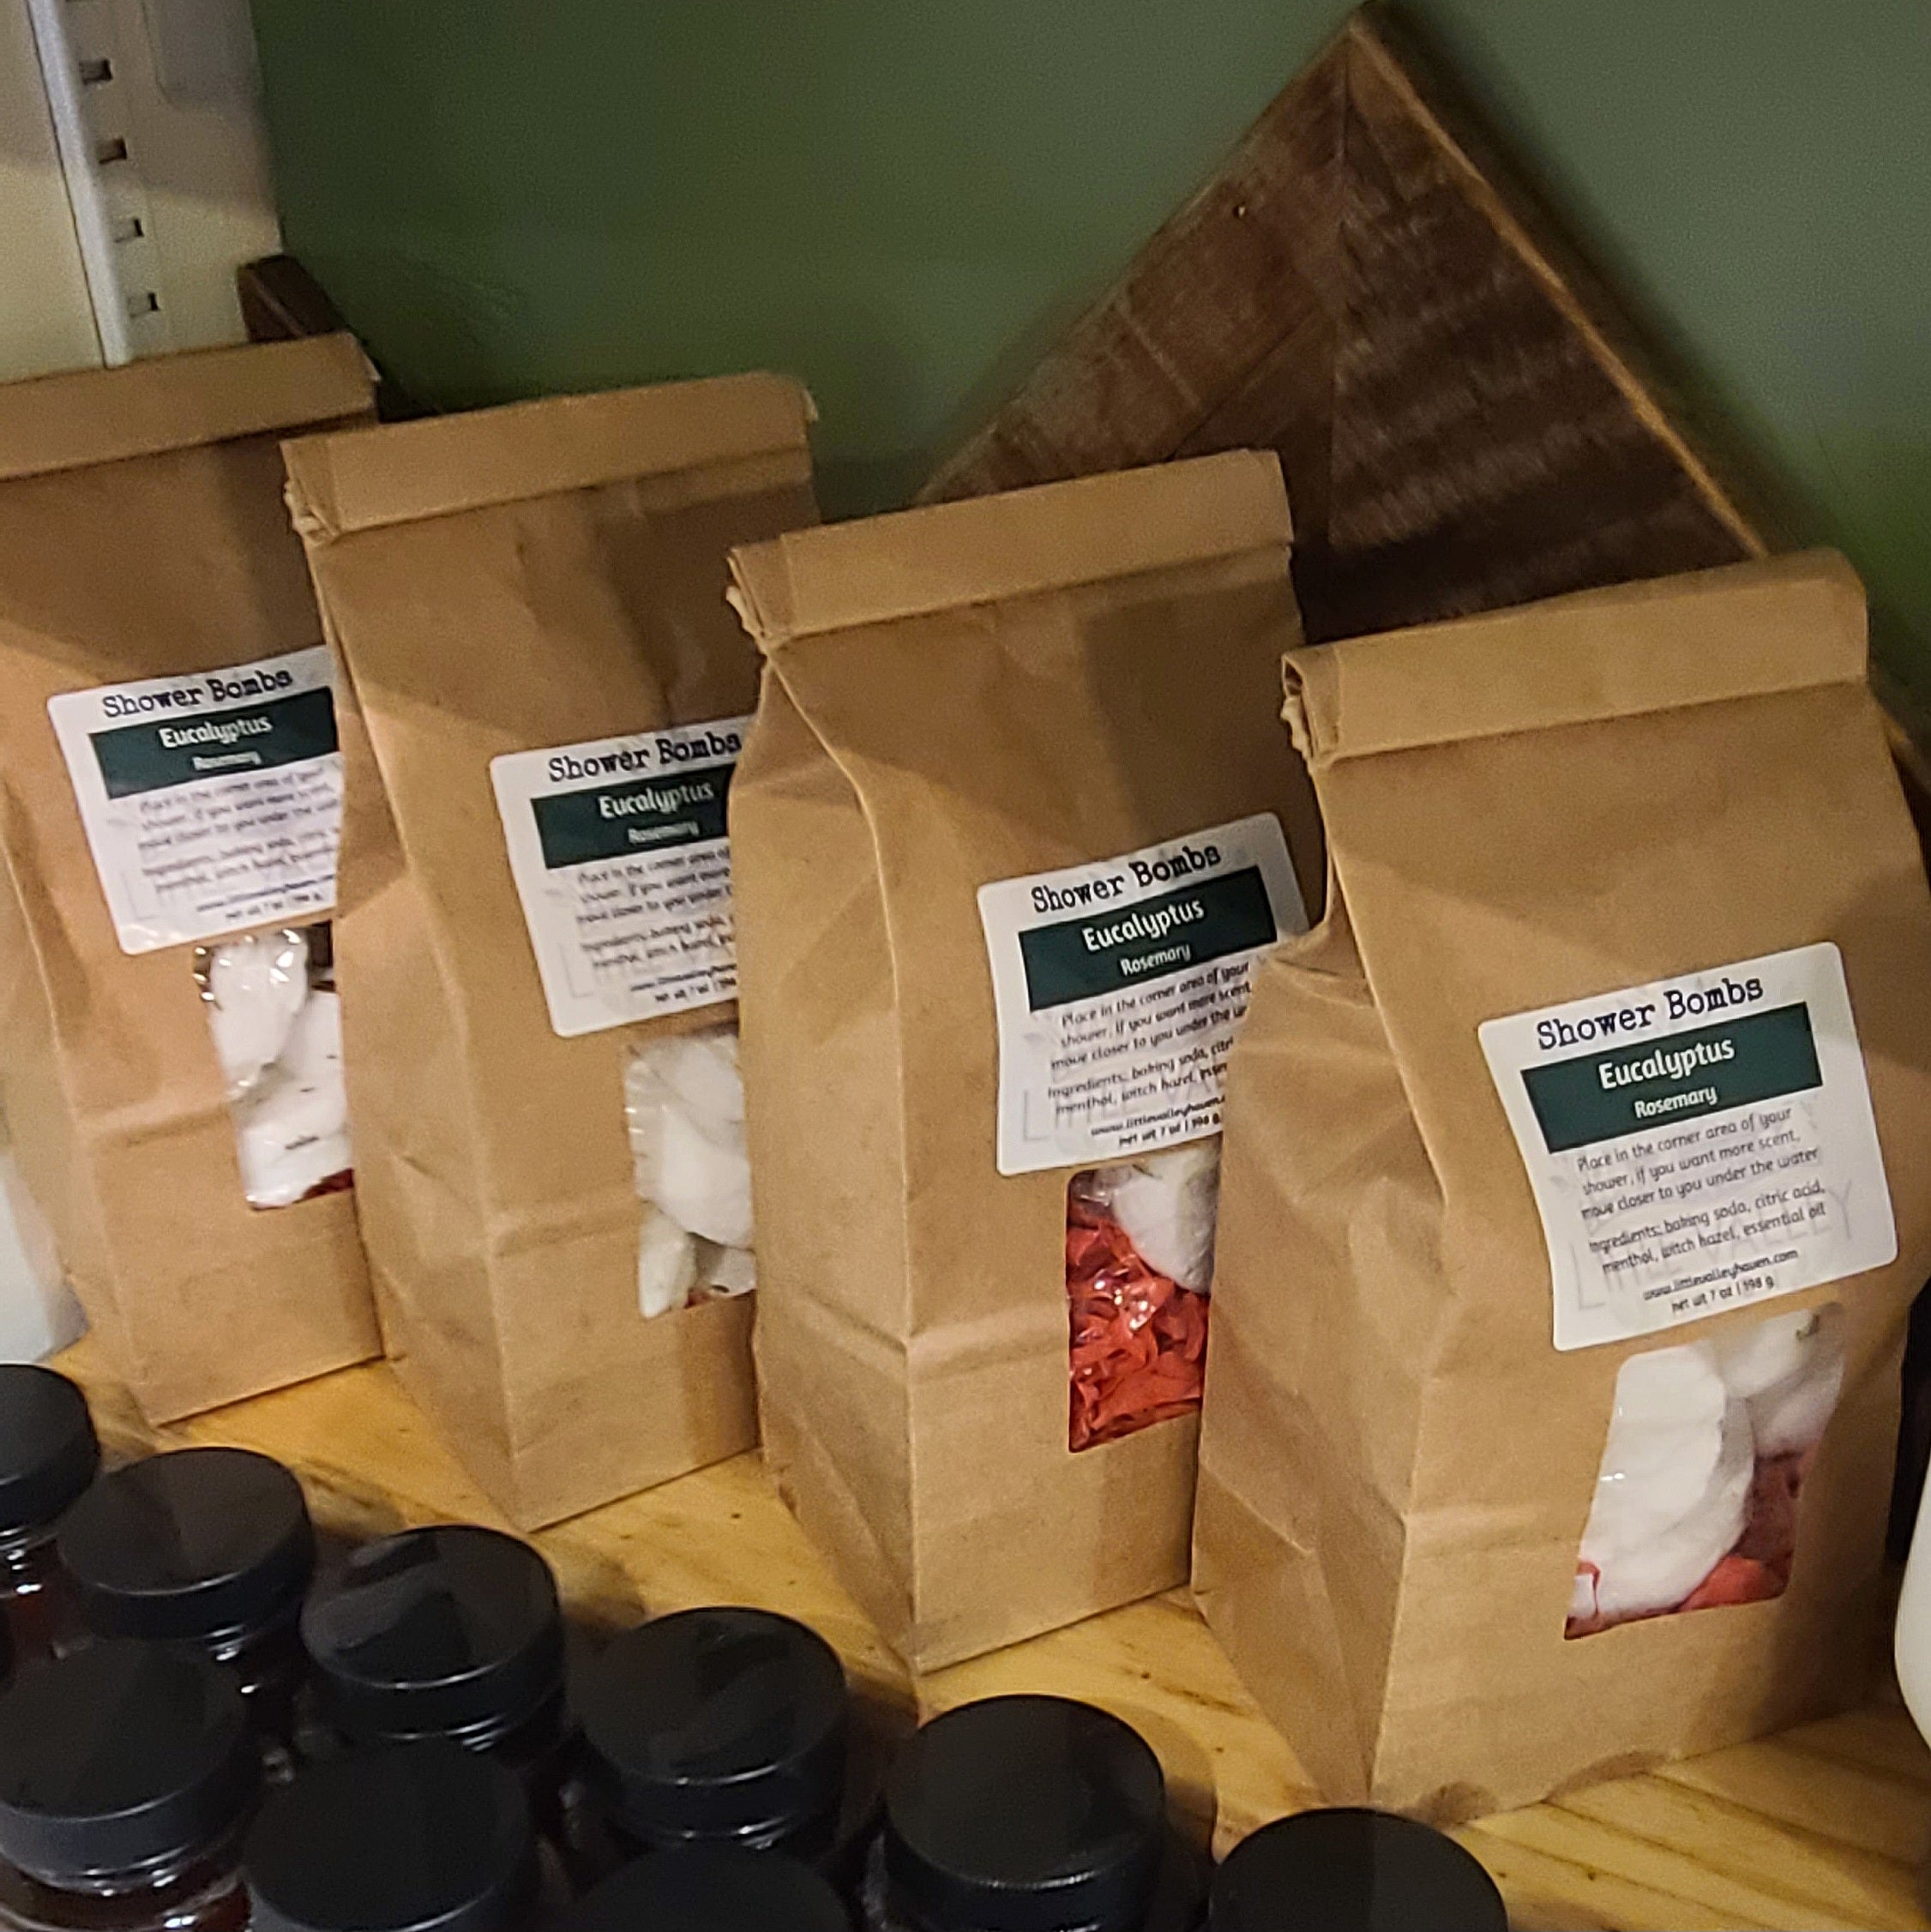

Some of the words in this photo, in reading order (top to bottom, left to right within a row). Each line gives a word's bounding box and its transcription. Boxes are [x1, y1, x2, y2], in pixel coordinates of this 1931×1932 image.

[104, 689, 202, 718] Shower
[208, 671, 292, 700] Bombs
[159, 717, 272, 749] Eucalyptus
[550, 750, 648, 782] Shower
[657, 731, 741, 763] Bombs
[599, 784, 714, 819] Eucalyptus
[1032, 876, 1123, 912] Shower
[1130, 846, 1220, 887] Bombs
[1083, 900, 1203, 951] Eucalyptus
[1121, 945, 1191, 976] Rosemary
[1062, 1008, 1098, 1029] Place
[1116, 996, 1137, 1013] the
[1140, 986, 1176, 1004] corner
[1221, 960, 1249, 984] your
[1537, 1004, 1654, 1050] Shower
[1664, 978, 1763, 1019] Bombs
[1128, 1014, 1152, 1032] you
[1133, 1036, 1147, 1051] to
[1150, 1028, 1174, 1048] you
[1598, 1039, 1735, 1089] Eucalyptus
[1635, 1087, 1717, 1118] Rosemary
[1576, 1153, 1612, 1173] Place
[1614, 1147, 1629, 1164] in
[1631, 1142, 1654, 1159] the
[1657, 1131, 1701, 1153] corner
[1705, 1122, 1738, 1140] area
[1740, 1112, 1755, 1133] of
[1759, 1107, 1792, 1130] your
[1648, 1162, 1675, 1183] you
[1677, 1149, 1716, 1171] want
[1718, 1141, 1754, 1159] more
[1580, 1203, 1615, 1221] move
[1617, 1191, 1656, 1212] closer
[1657, 1185, 1674, 1201] to
[1675, 1178, 1703, 1200] you
[1705, 1166, 1748, 1188] under
[1749, 1159, 1774, 1176] the
[1776, 1146, 1820, 1169] water
[1660, 1237, 1696, 1260] witch
[1742, 1206, 1806, 1236] essential
[1808, 1201, 1826, 1220] oil
[1662, 1212, 1711, 1235] baking
[1754, 1188, 1790, 1210] citric
